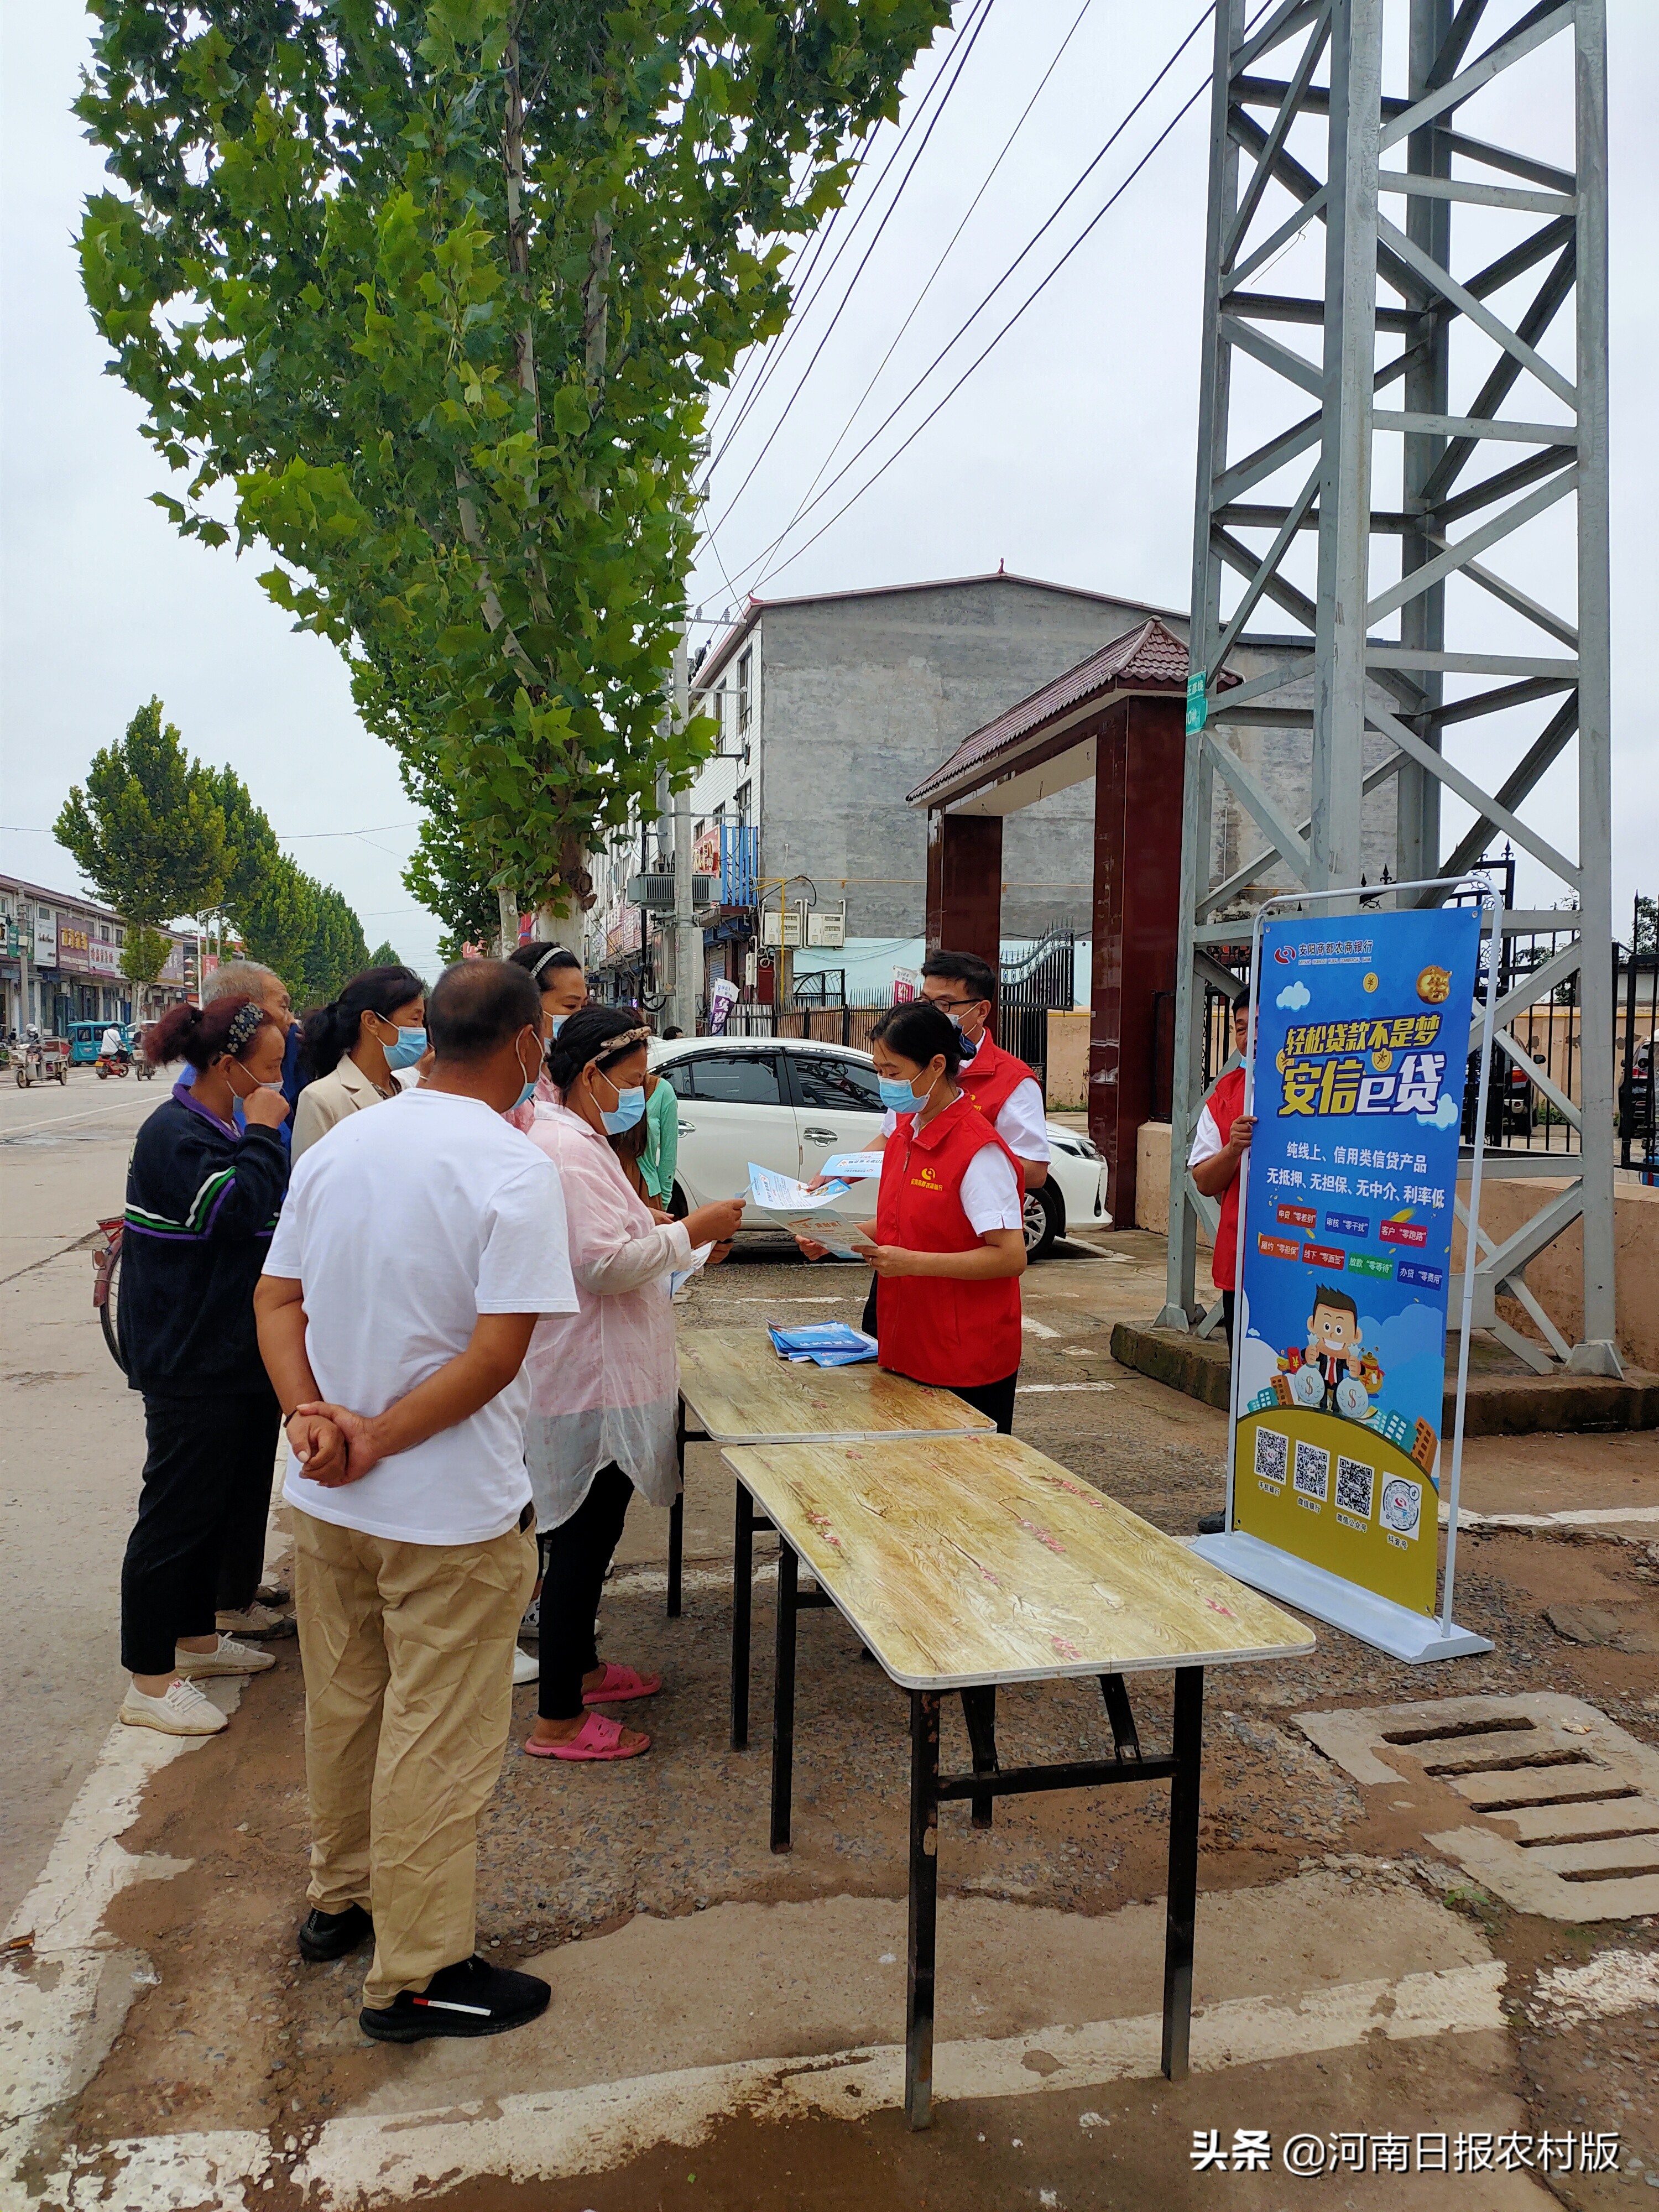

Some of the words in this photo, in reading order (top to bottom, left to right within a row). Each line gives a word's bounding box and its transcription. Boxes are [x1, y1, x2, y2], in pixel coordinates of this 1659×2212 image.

[1299, 940, 1373, 957] 安阳商都农商银行
[1286, 1014, 1441, 1056] 轻松贷款不是梦
[1286, 1141, 1427, 1173] 纯线上、信用类信贷产品
[1266, 1167, 1445, 1209] 无抵押、无担保、无中介、利率低
[1258, 1481, 1281, 1496] 手机银行
[1297, 1496, 1321, 1514] 微信银行
[1336, 1513, 1368, 1533] 微信公众号
[1387, 1533, 1408, 1550] 抖音号
